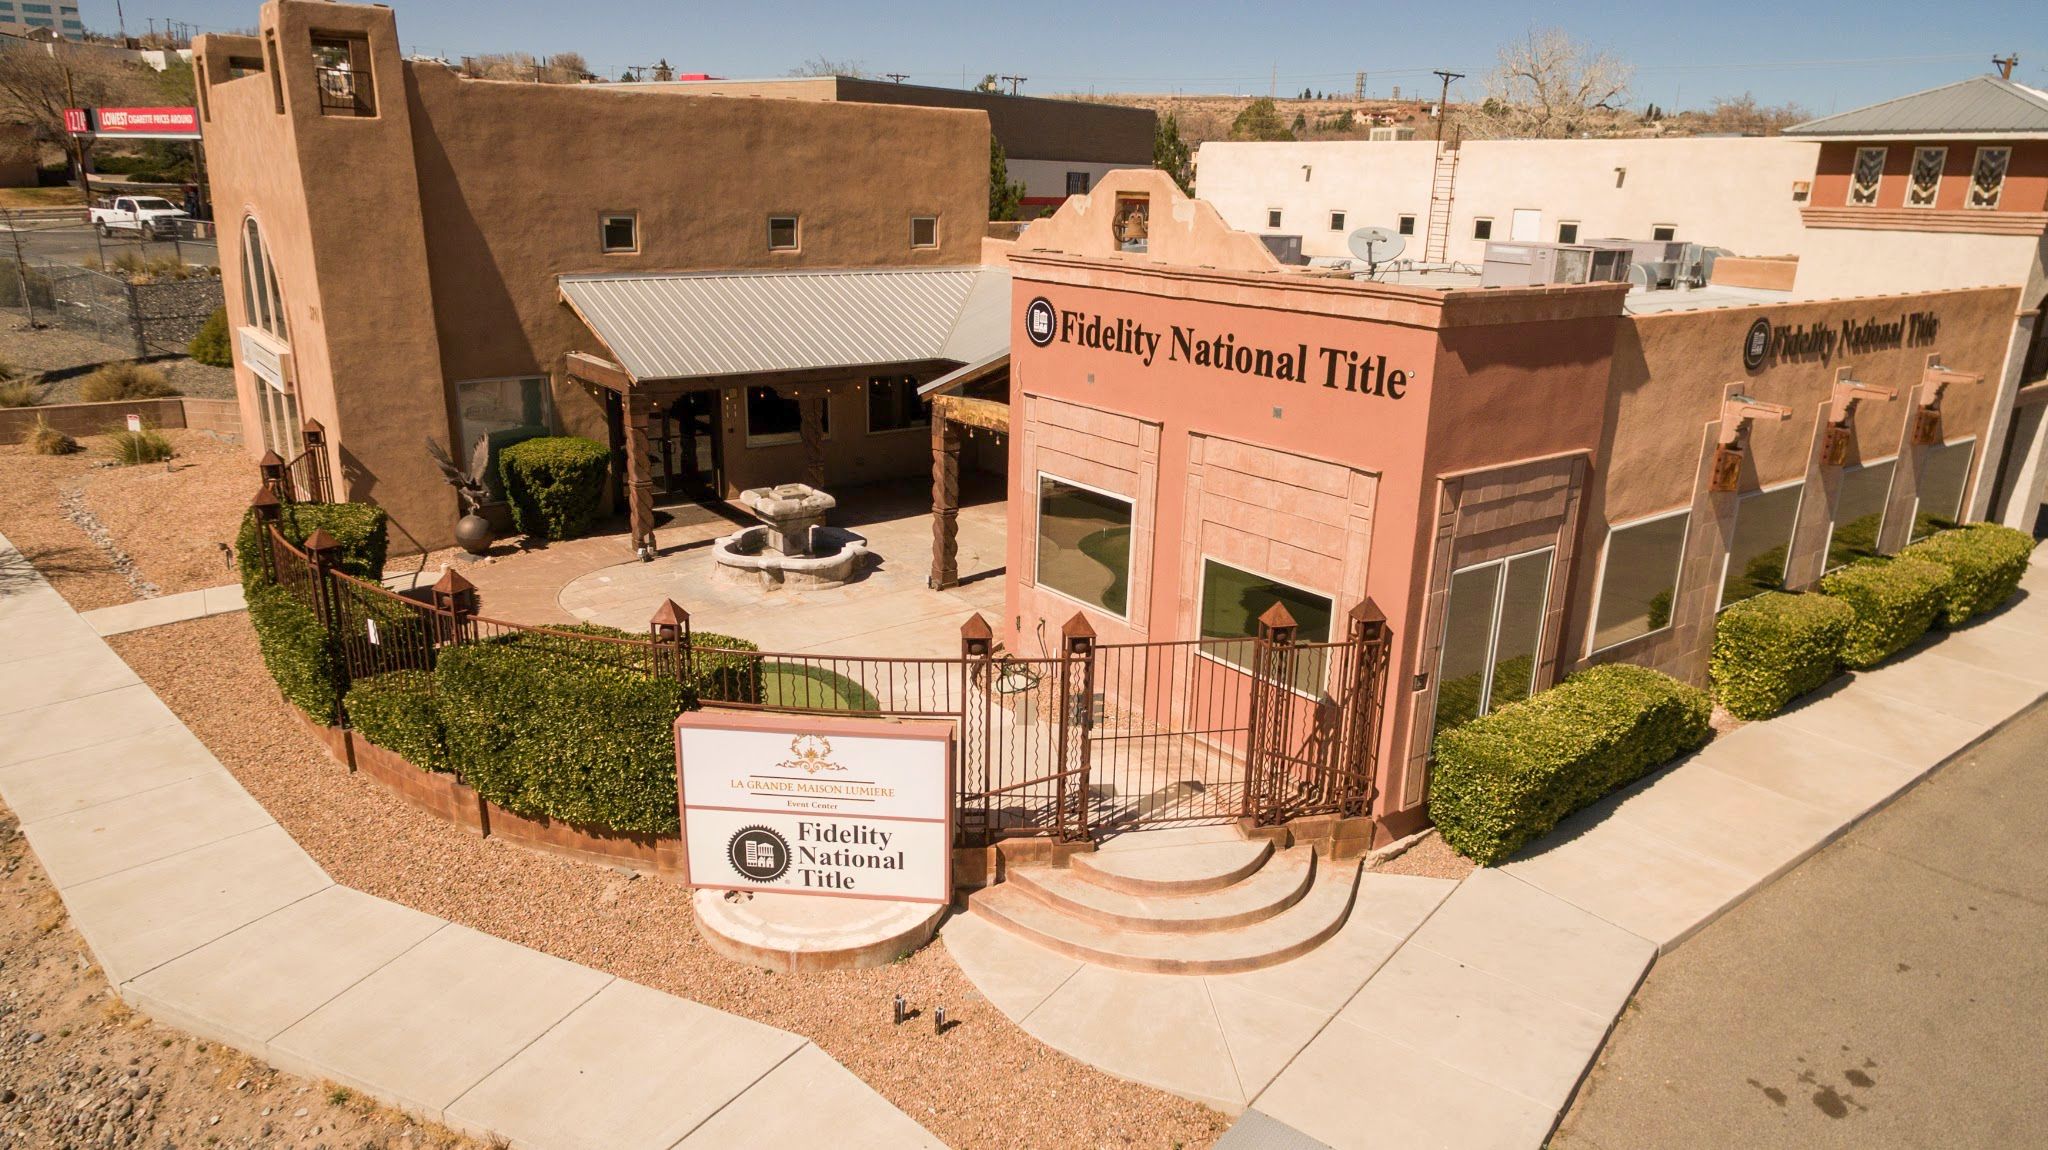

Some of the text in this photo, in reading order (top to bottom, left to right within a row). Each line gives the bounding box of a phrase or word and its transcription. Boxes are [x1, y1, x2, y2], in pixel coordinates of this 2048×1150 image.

[102, 112, 193, 126] LOWEST CIGARETTE PRICES AROUND
[1772, 311, 1937, 361] Fidelity National Title
[1060, 310, 1408, 400] Fidelity National Title
[730, 779, 895, 798] LA GRANDE MAISON LUMIERE
[787, 800, 839, 810] Event Center
[798, 822, 893, 851] Fidelity
[798, 846, 904, 870] National
[798, 869, 855, 890] Title
